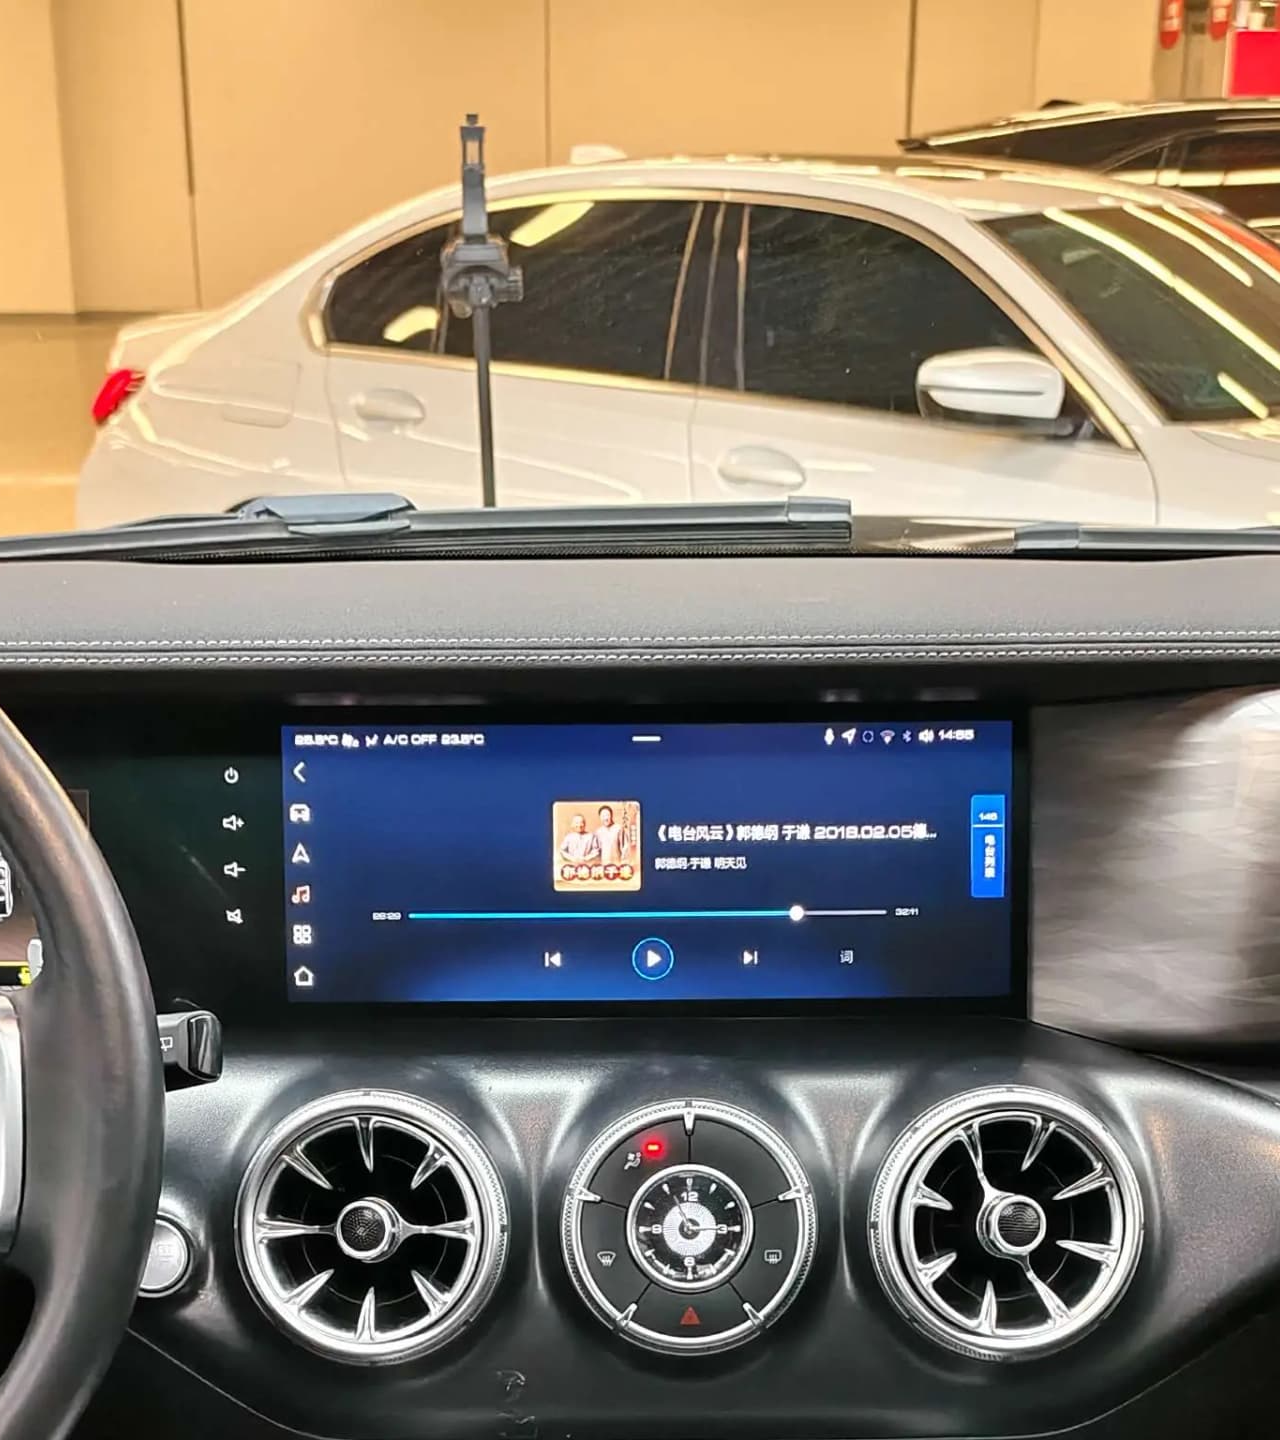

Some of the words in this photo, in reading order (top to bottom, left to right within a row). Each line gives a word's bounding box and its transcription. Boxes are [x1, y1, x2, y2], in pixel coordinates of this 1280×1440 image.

[383, 734, 408, 745] A/C
[410, 734, 437, 745] OFF
[839, 949, 854, 964] 词
[680, 1191, 699, 1202] 12
